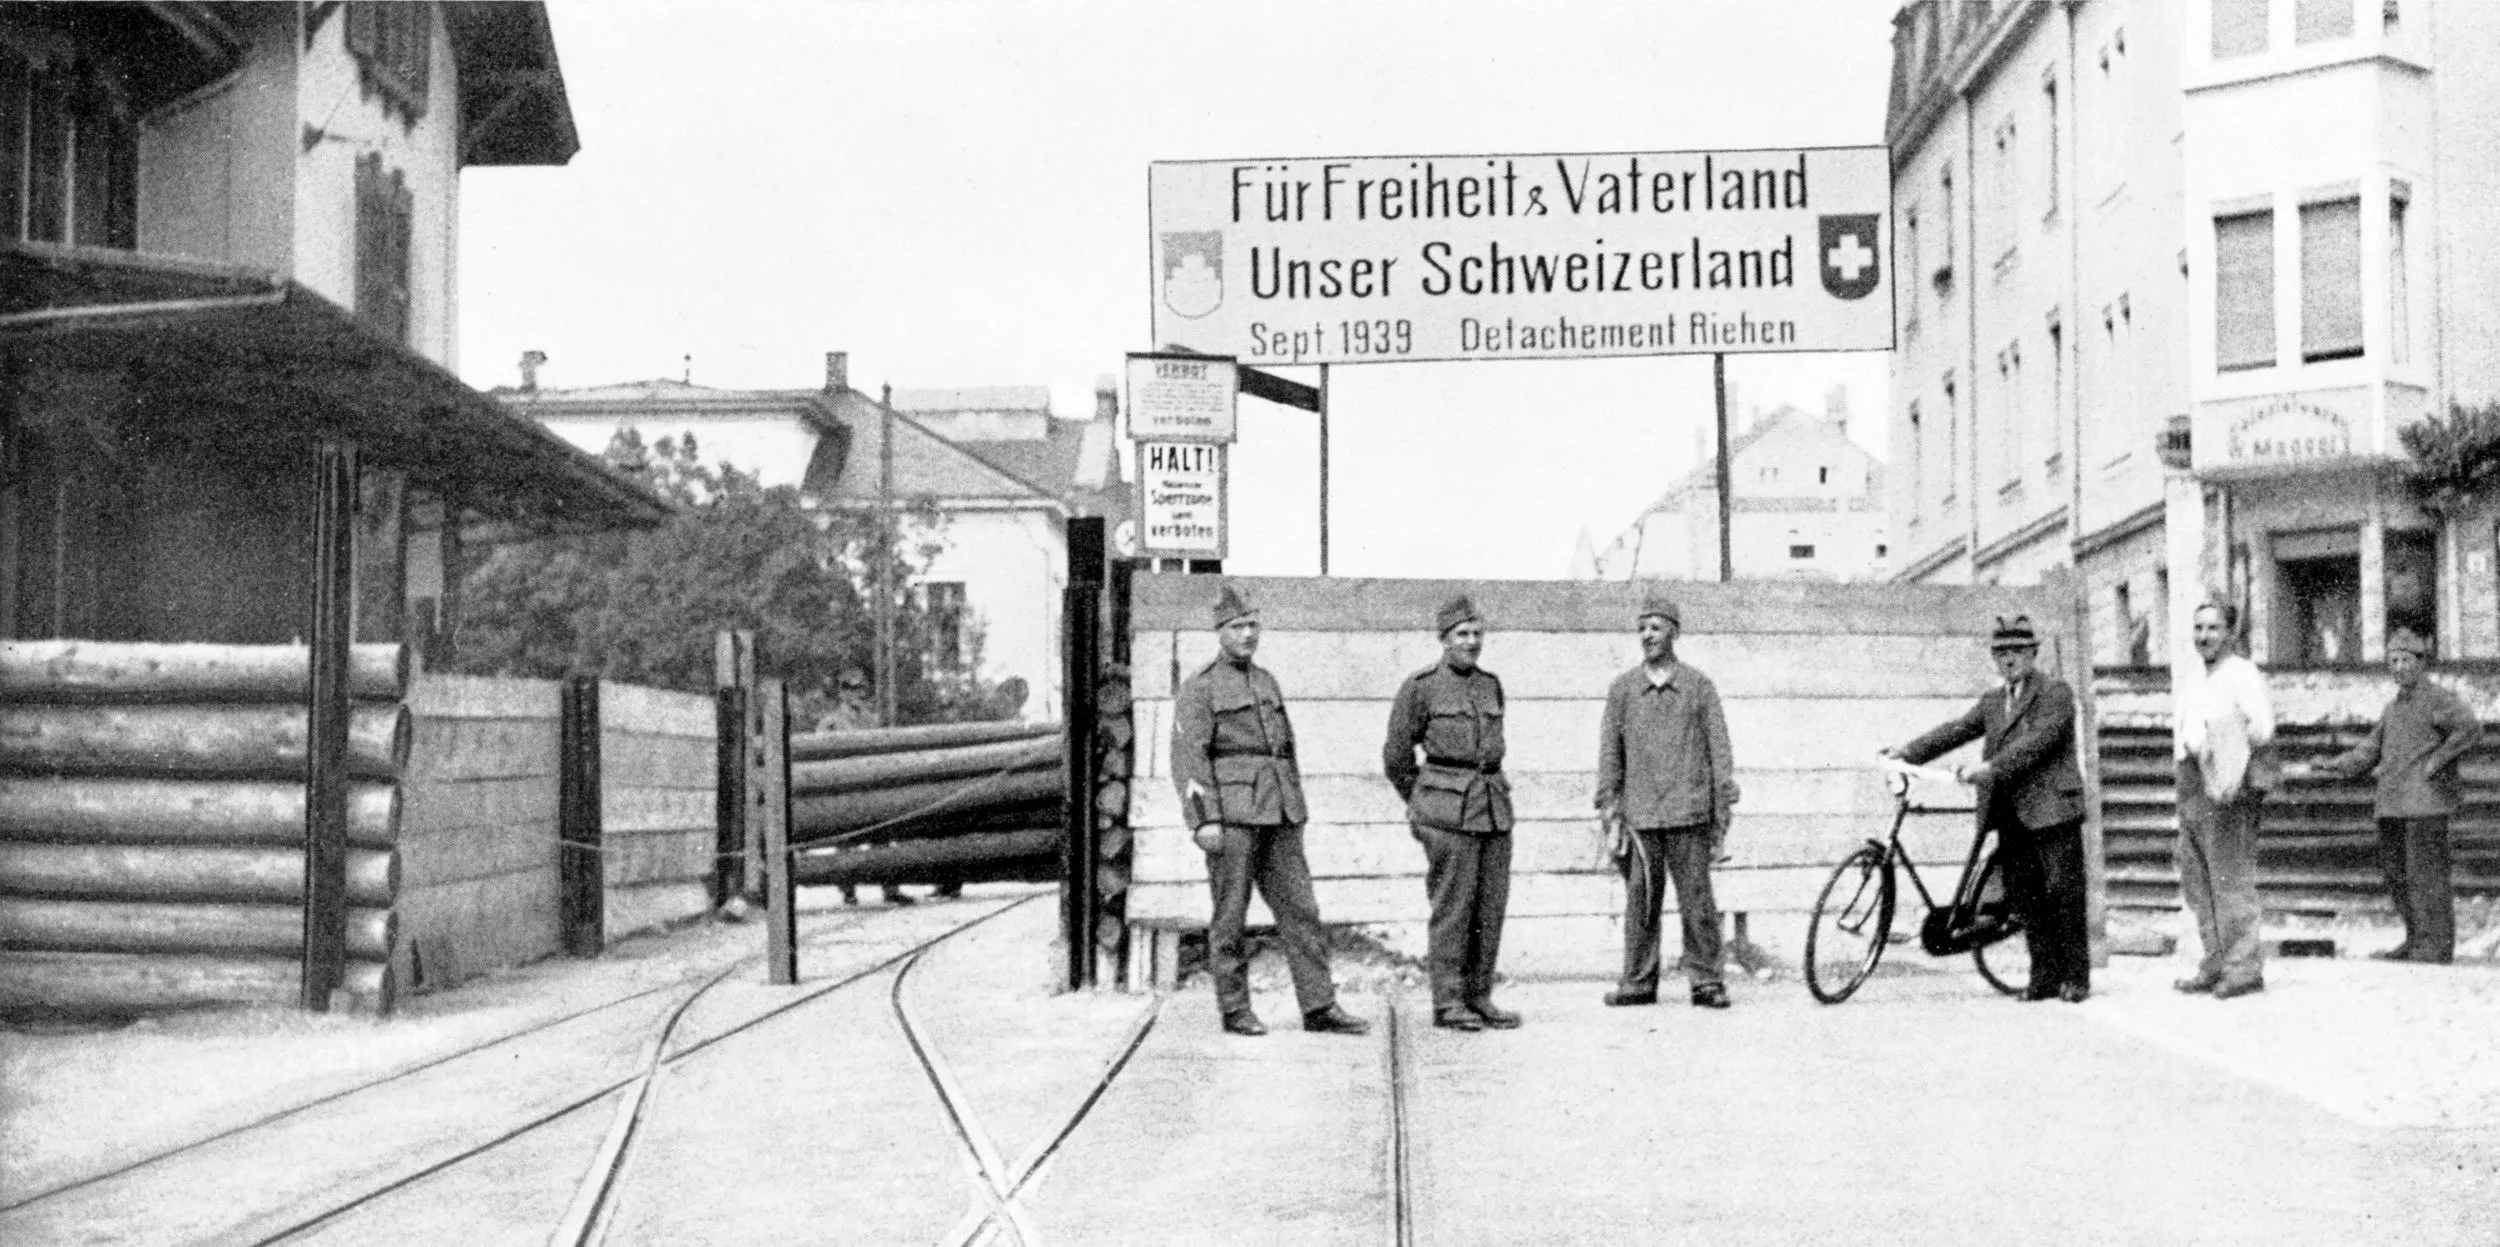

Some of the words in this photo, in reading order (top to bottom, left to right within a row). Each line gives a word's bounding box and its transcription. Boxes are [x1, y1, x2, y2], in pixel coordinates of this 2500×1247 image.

[1232, 165, 1312, 223] Für
[1323, 160, 1519, 221] Freiheit
[1523, 185, 1549, 217] &
[1555, 152, 1809, 214] Vaterland
[1250, 246, 1399, 299] Unser
[1420, 234, 1795, 296] Schweizerland
[1340, 319, 1412, 356] 1939
[1461, 315, 1675, 352] Detachement
[1690, 311, 1796, 346] Riehen
[1150, 446, 1214, 473] HALT!
[1151, 524, 1213, 538] verboten
